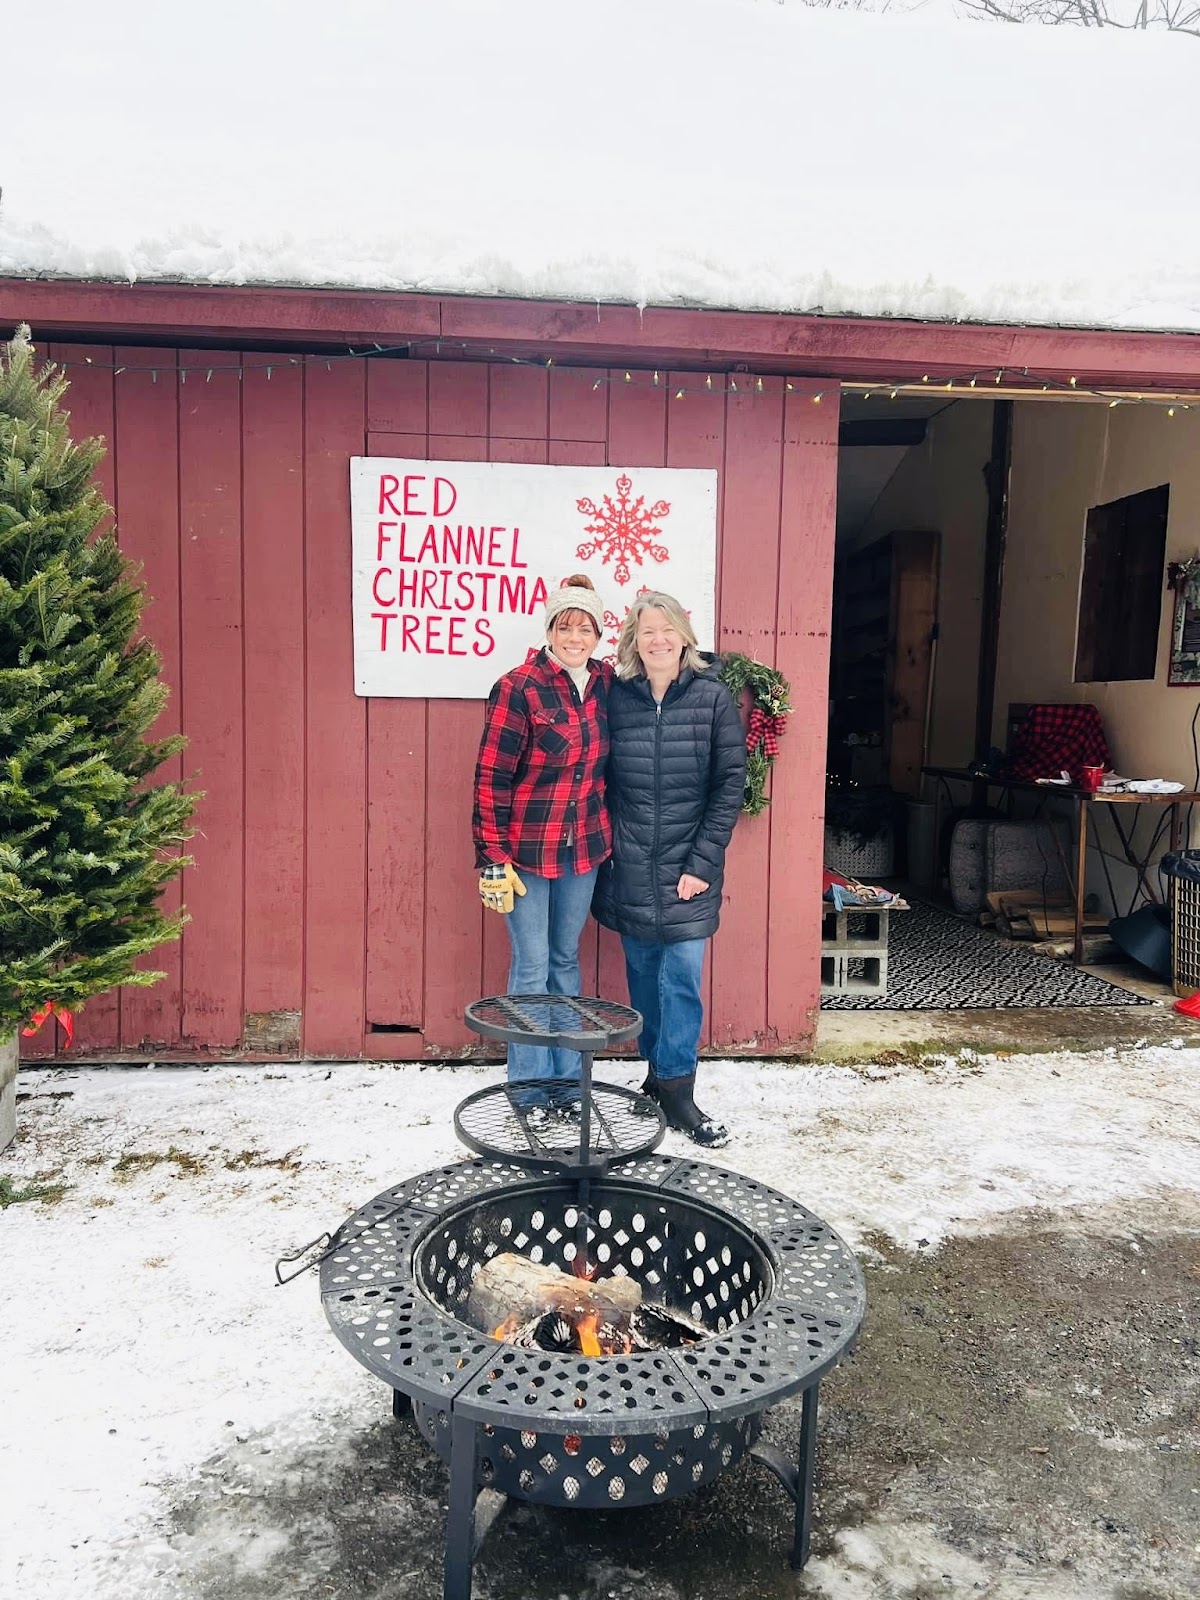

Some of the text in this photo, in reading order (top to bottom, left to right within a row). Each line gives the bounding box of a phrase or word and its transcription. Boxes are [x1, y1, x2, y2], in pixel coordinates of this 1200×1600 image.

[378, 473, 458, 517] RED
[376, 521, 528, 569] FLANNEL
[372, 566, 570, 616] CHRISTMA
[370, 612, 496, 658] TREES
